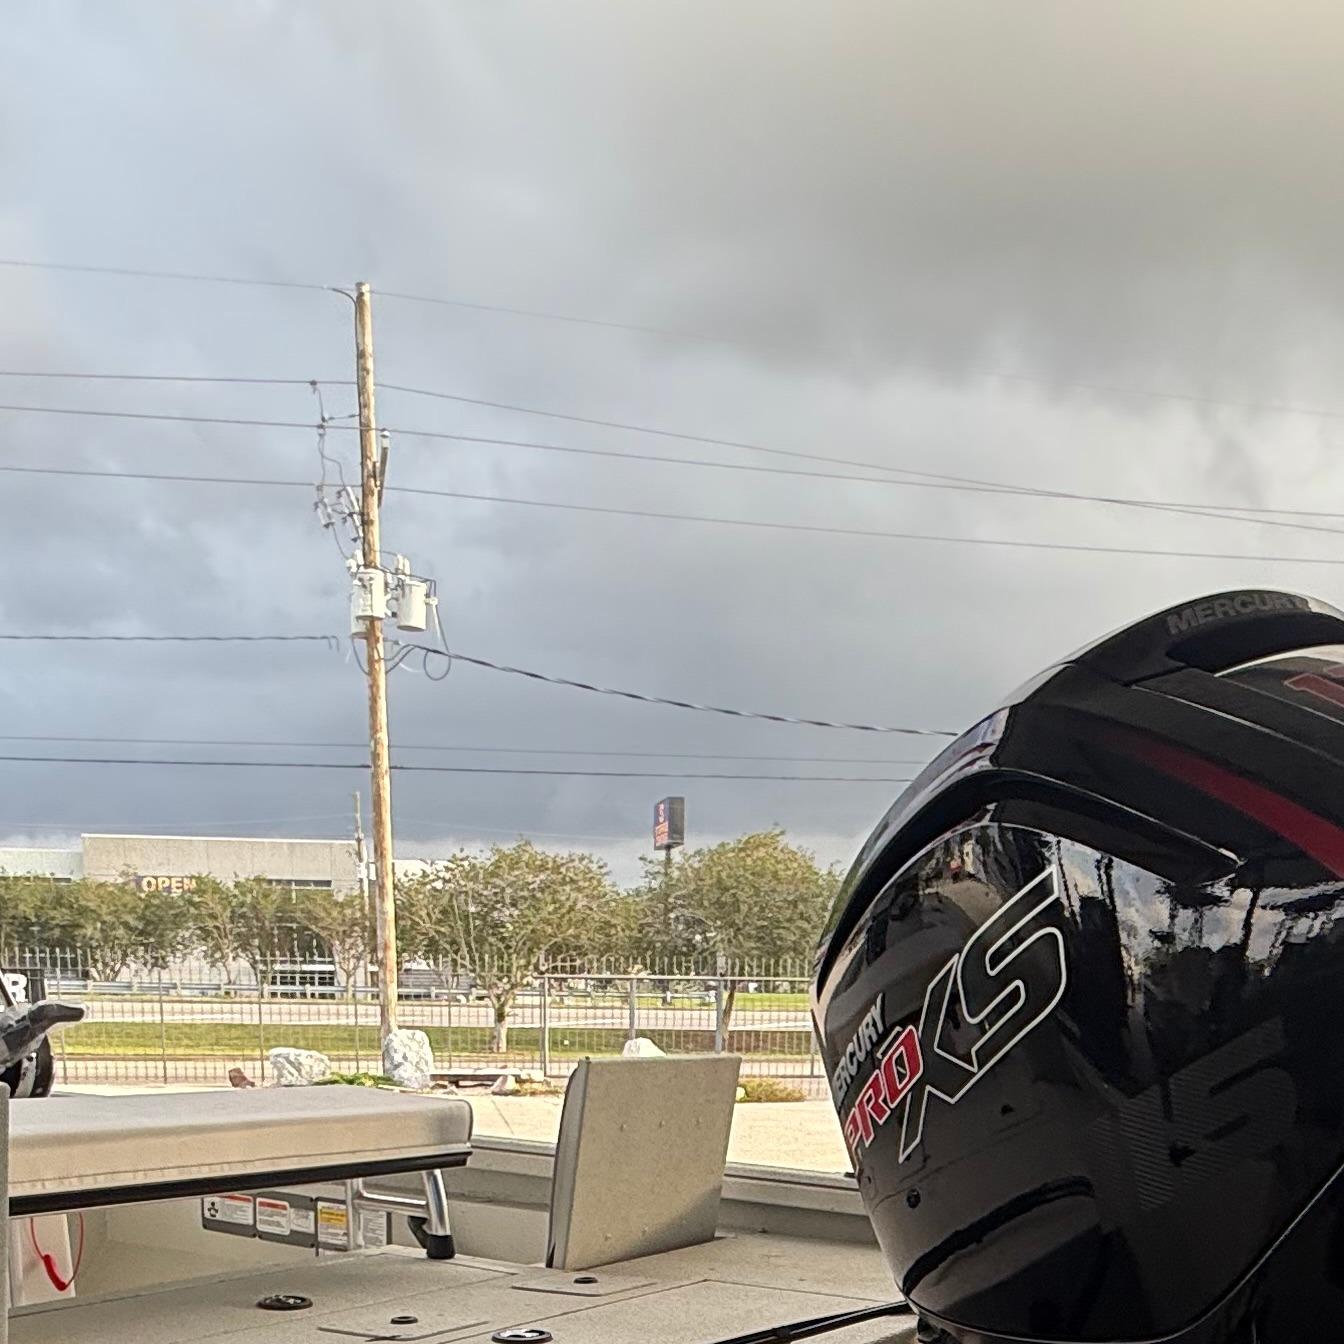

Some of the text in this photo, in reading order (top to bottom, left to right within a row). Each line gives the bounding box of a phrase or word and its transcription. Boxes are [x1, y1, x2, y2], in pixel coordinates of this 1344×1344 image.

[141, 876, 197, 892] OPEN
[832, 991, 885, 1109] ERCURY
[898, 864, 1067, 1164] XS
